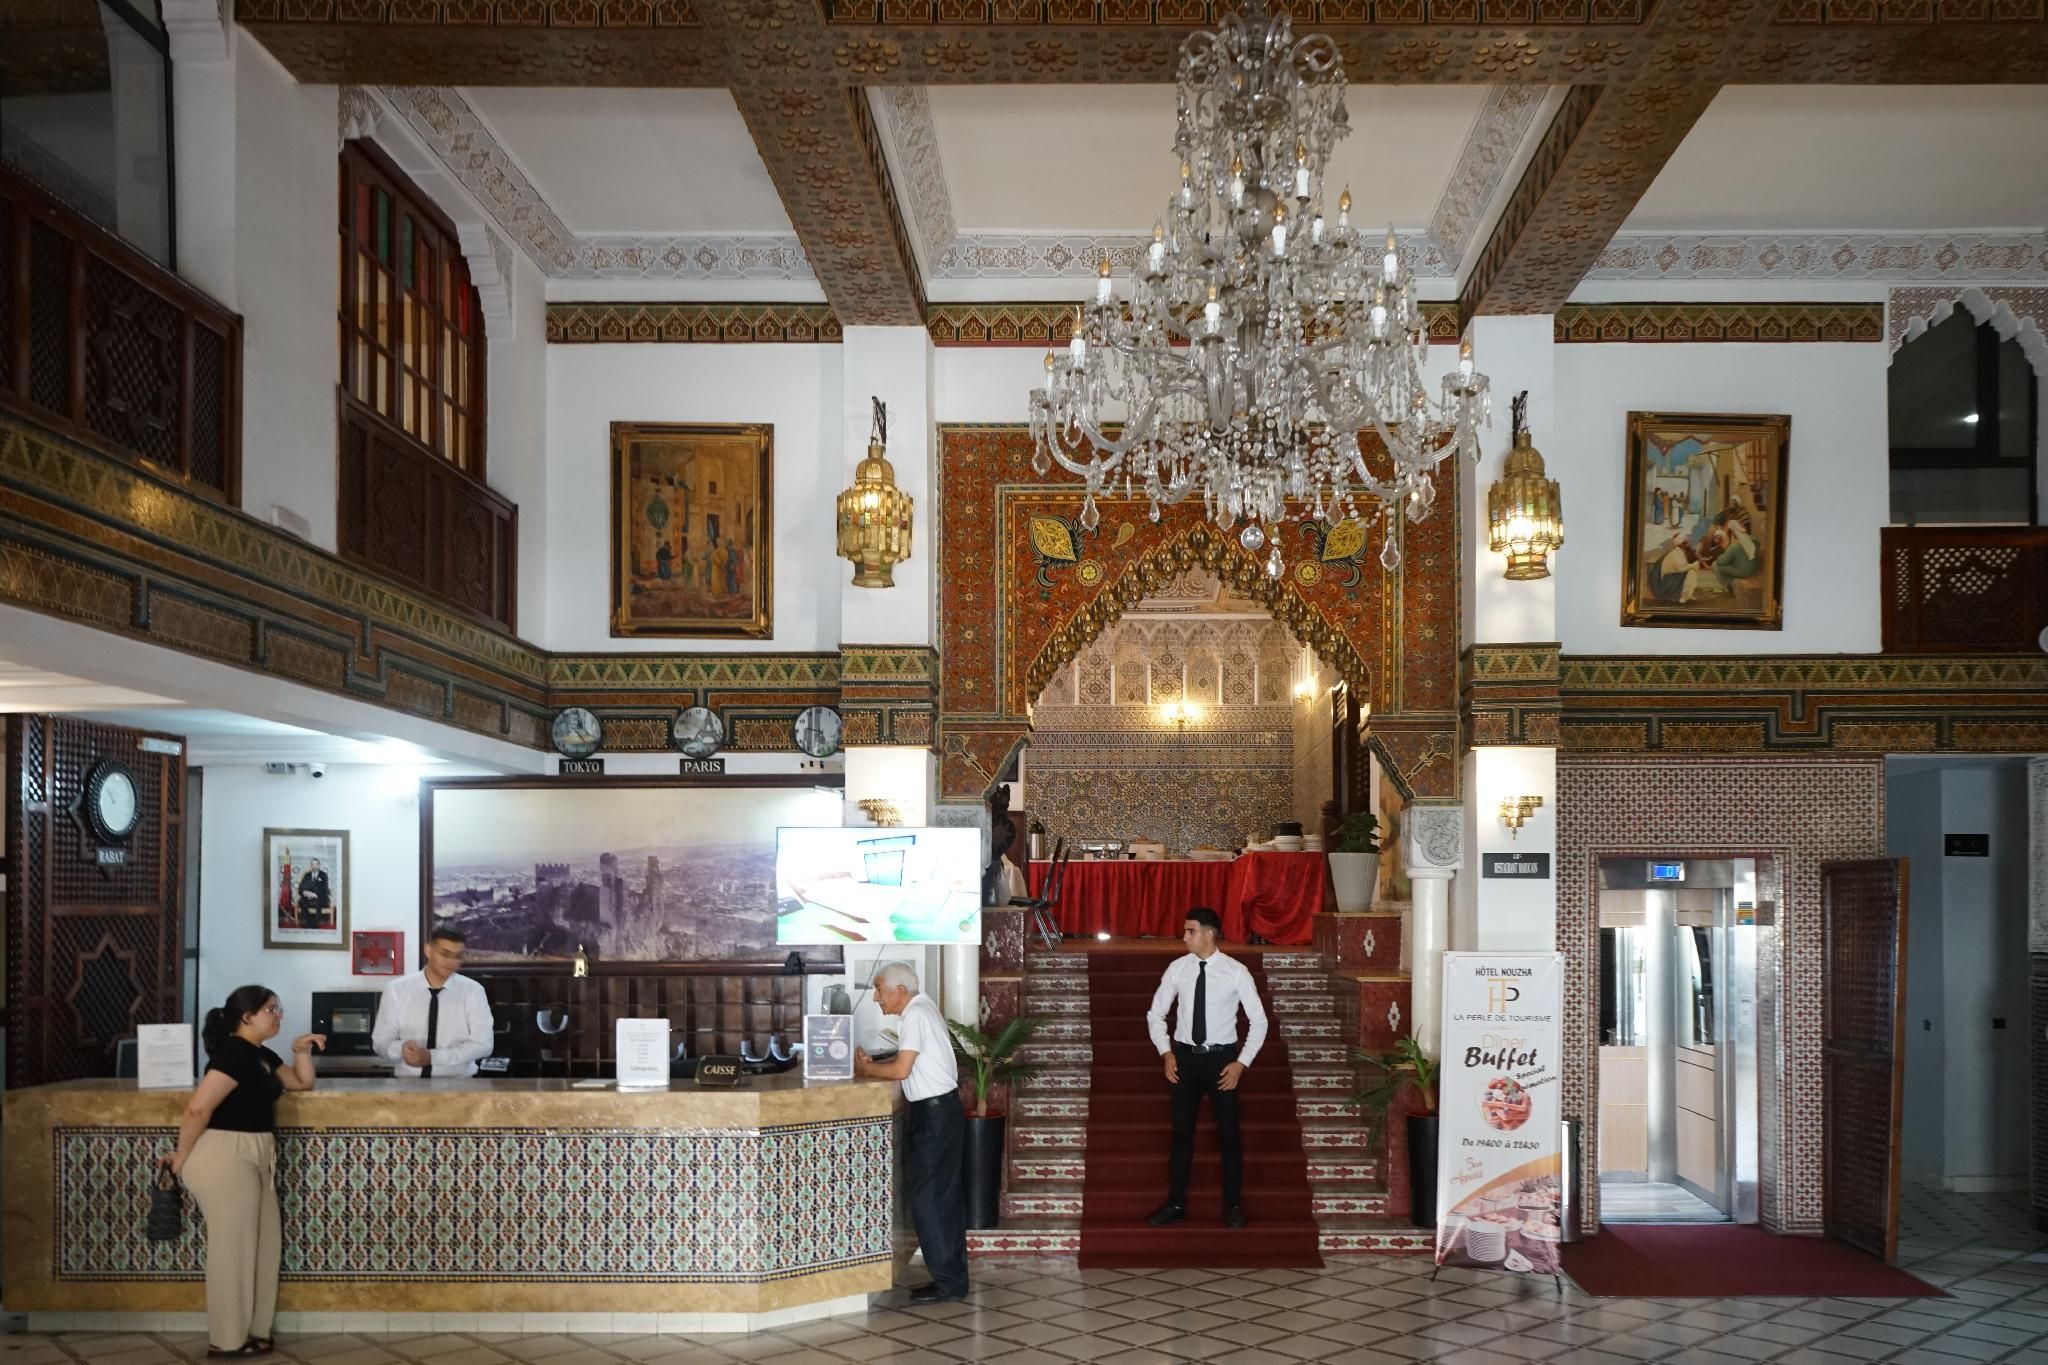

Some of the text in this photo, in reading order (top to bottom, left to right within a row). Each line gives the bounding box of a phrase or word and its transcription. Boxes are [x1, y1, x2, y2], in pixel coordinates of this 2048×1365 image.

[563, 761, 600, 773] TOKYO
[684, 760, 721, 773] PARIS
[98, 849, 125, 865] RABAT
[1475, 965, 1533, 977] HÔTEL NOUZHA
[1494, 1014, 1507, 1022] DE
[1509, 1014, 1552, 1023] TOURISME
[1464, 1046, 1538, 1070] Buffet
[703, 1064, 737, 1075] CAISSE
[1461, 1137, 1474, 1147] De
